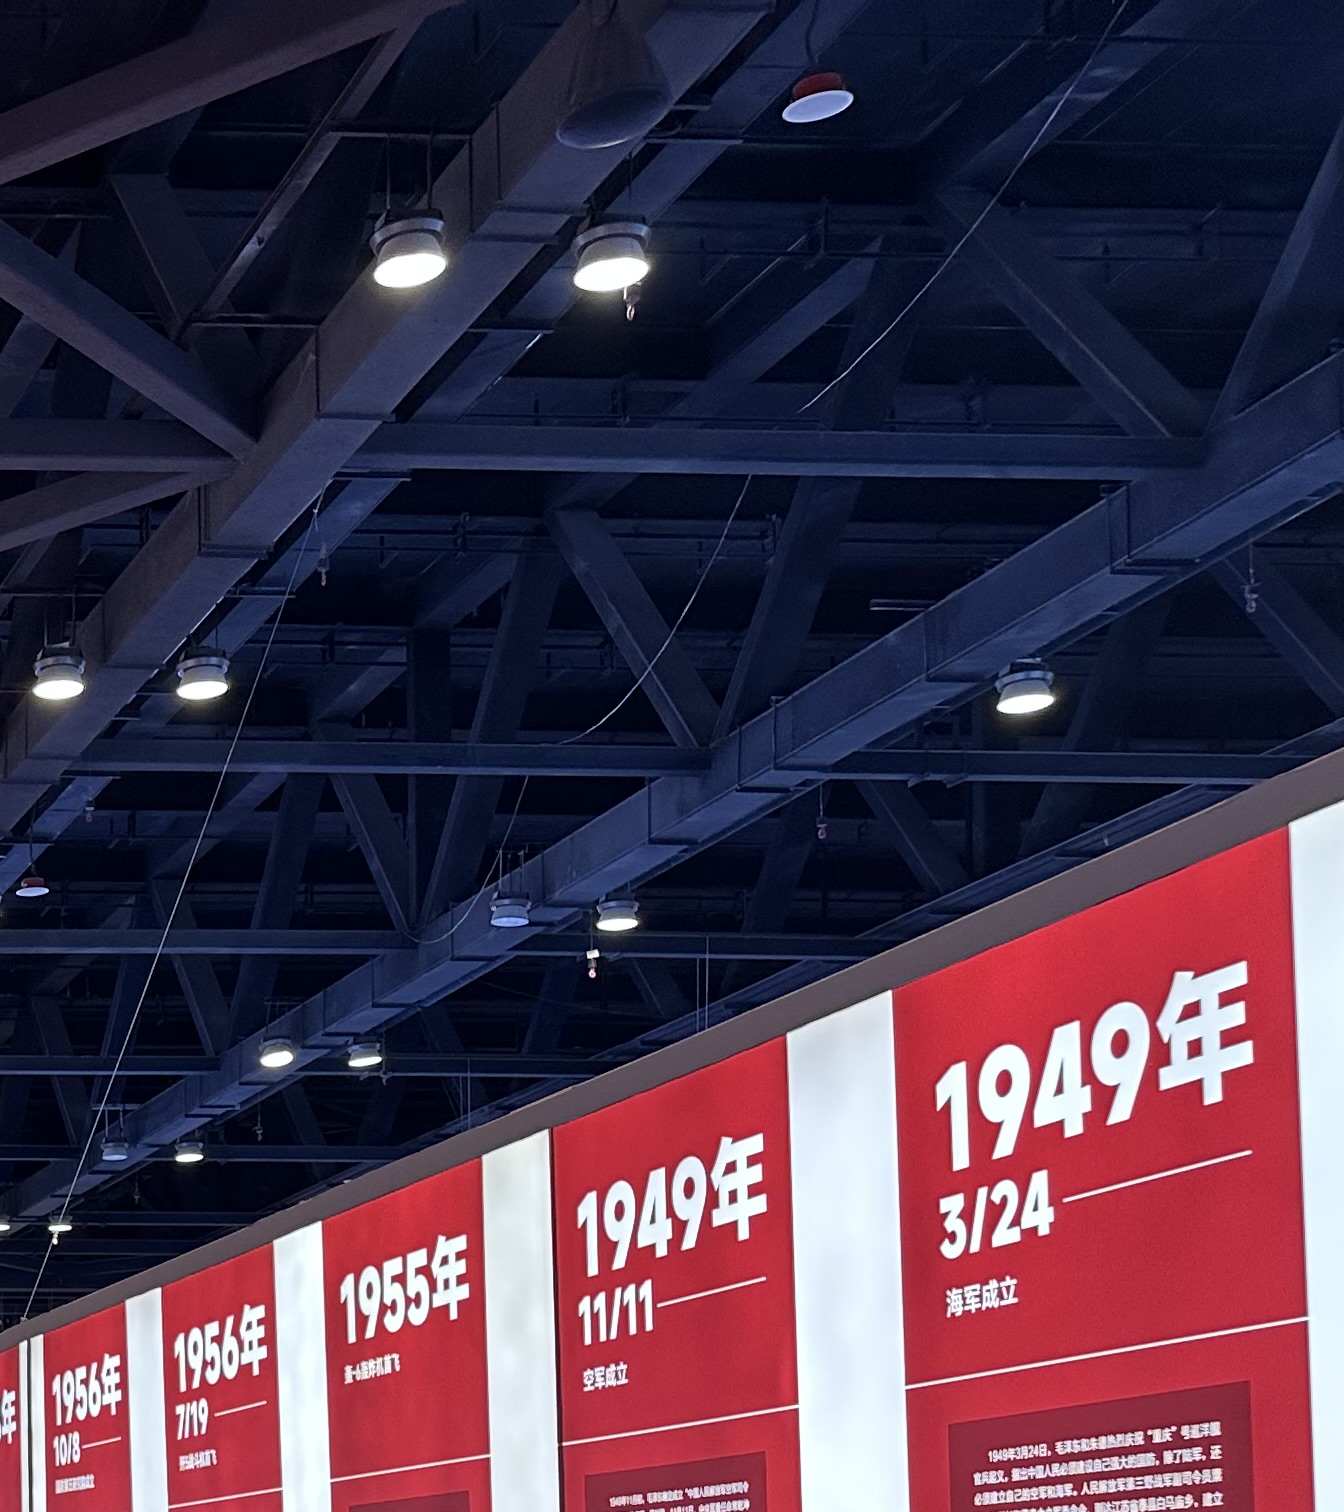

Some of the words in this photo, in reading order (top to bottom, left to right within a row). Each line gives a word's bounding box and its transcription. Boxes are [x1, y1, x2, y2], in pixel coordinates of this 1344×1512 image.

[935, 960, 1254, 1172] 1949年
[576, 1132, 768, 1278] 1949年
[939, 1169, 1055, 1260] 3/24
[340, 1234, 470, 1345] 1955年
[578, 1279, 654, 1346] 11/11
[946, 1276, 1019, 1318] 海军成立
[174, 1304, 267, 1393] 1956年
[583, 1361, 629, 1392] 空军成立
[52, 1353, 122, 1426] 1956年
[175, 1398, 209, 1440] 7/19
[52, 1431, 81, 1467] 10/8
